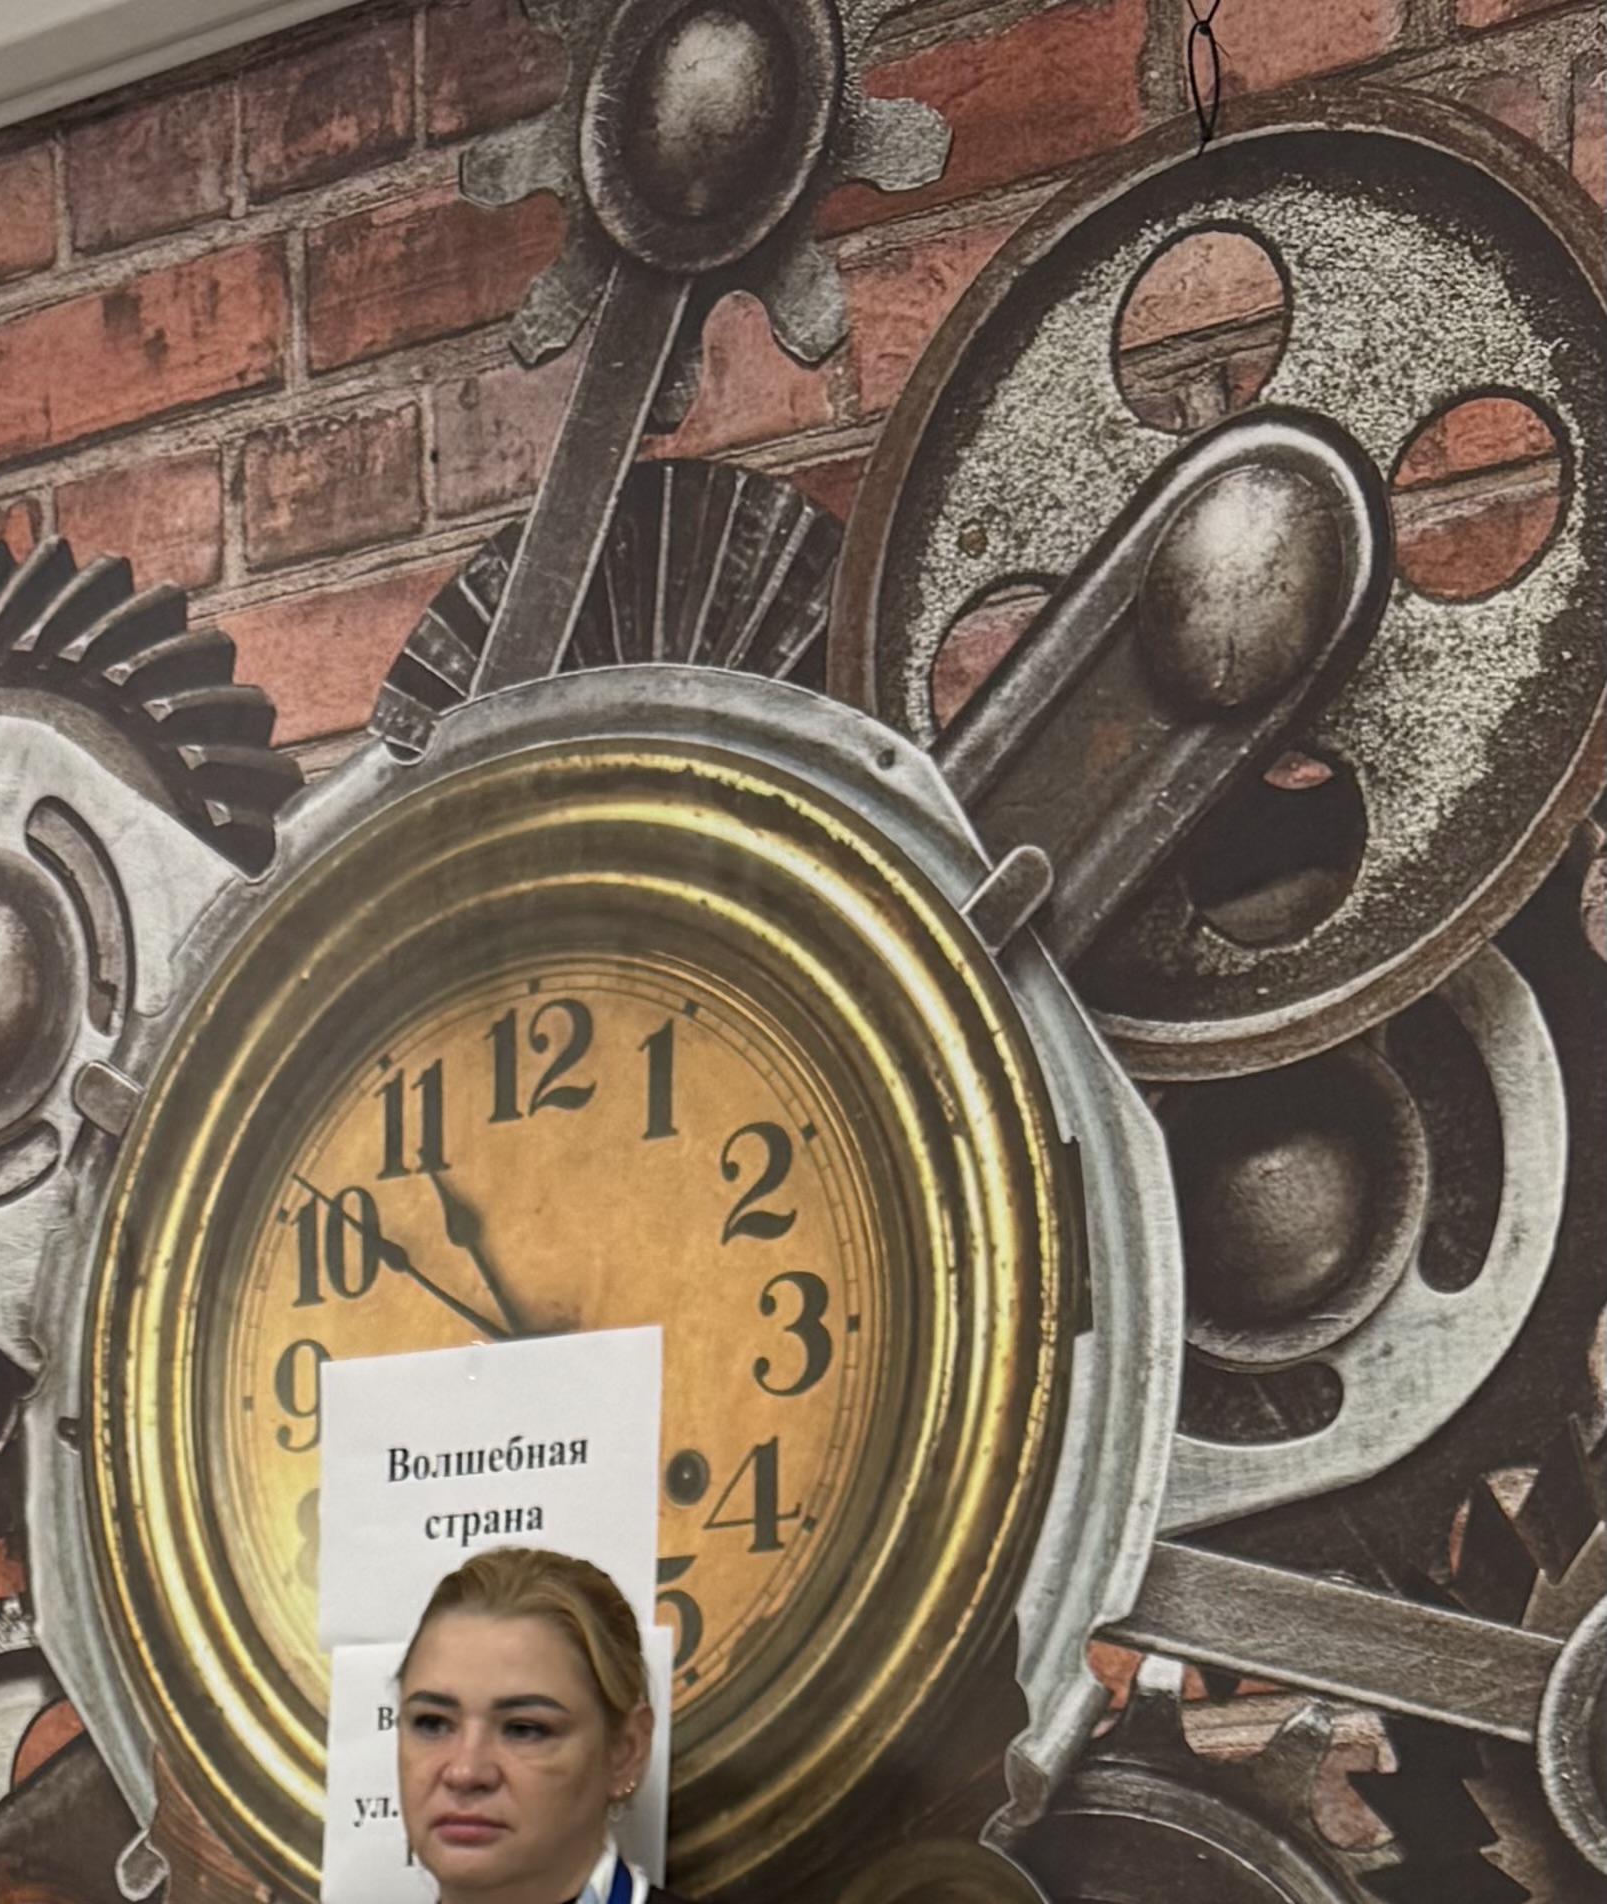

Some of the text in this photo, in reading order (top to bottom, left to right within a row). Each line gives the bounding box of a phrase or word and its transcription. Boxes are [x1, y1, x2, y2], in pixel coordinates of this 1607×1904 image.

[375, 1058, 450, 1180] 11
[487, 998, 597, 1123] 12
[640, 1018, 678, 1139] 1
[720, 1121, 797, 1245] 2
[291, 1186, 382, 1308] 10
[753, 1271, 832, 1396] 3
[275, 1339, 332, 1453] 9
[387, 1434, 588, 1483] Волшебная
[703, 1435, 799, 1554] 4
[424, 1505, 544, 1548] страна
[353, 1796, 399, 1828] ул.
